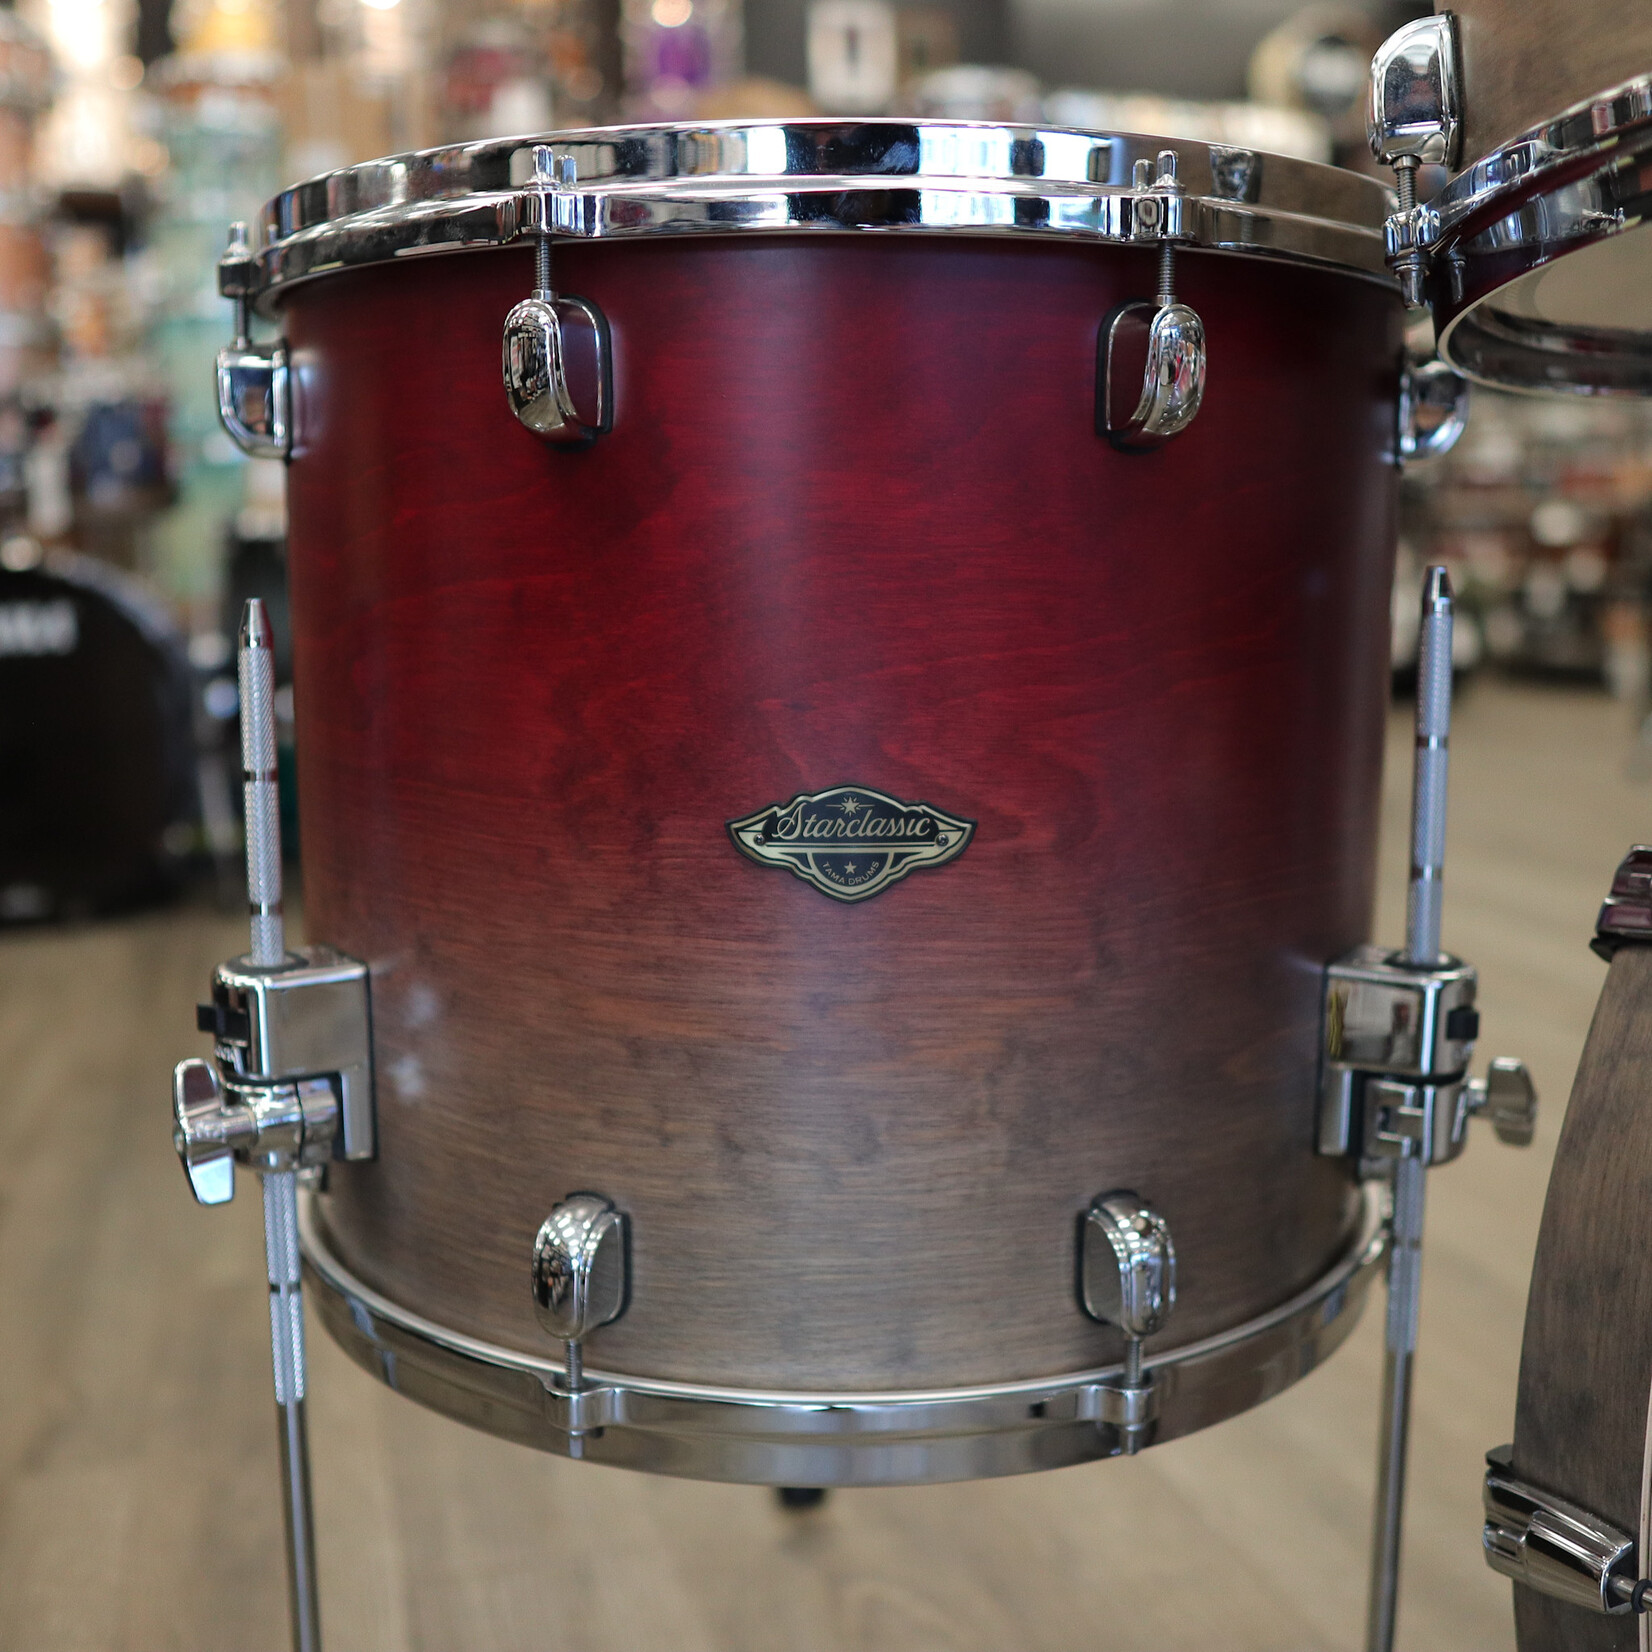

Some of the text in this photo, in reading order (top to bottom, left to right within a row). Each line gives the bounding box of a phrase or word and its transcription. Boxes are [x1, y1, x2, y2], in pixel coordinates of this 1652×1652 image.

[771, 802, 931, 840] Starclassic
[822, 861, 880, 886] TAMA DRUMS
